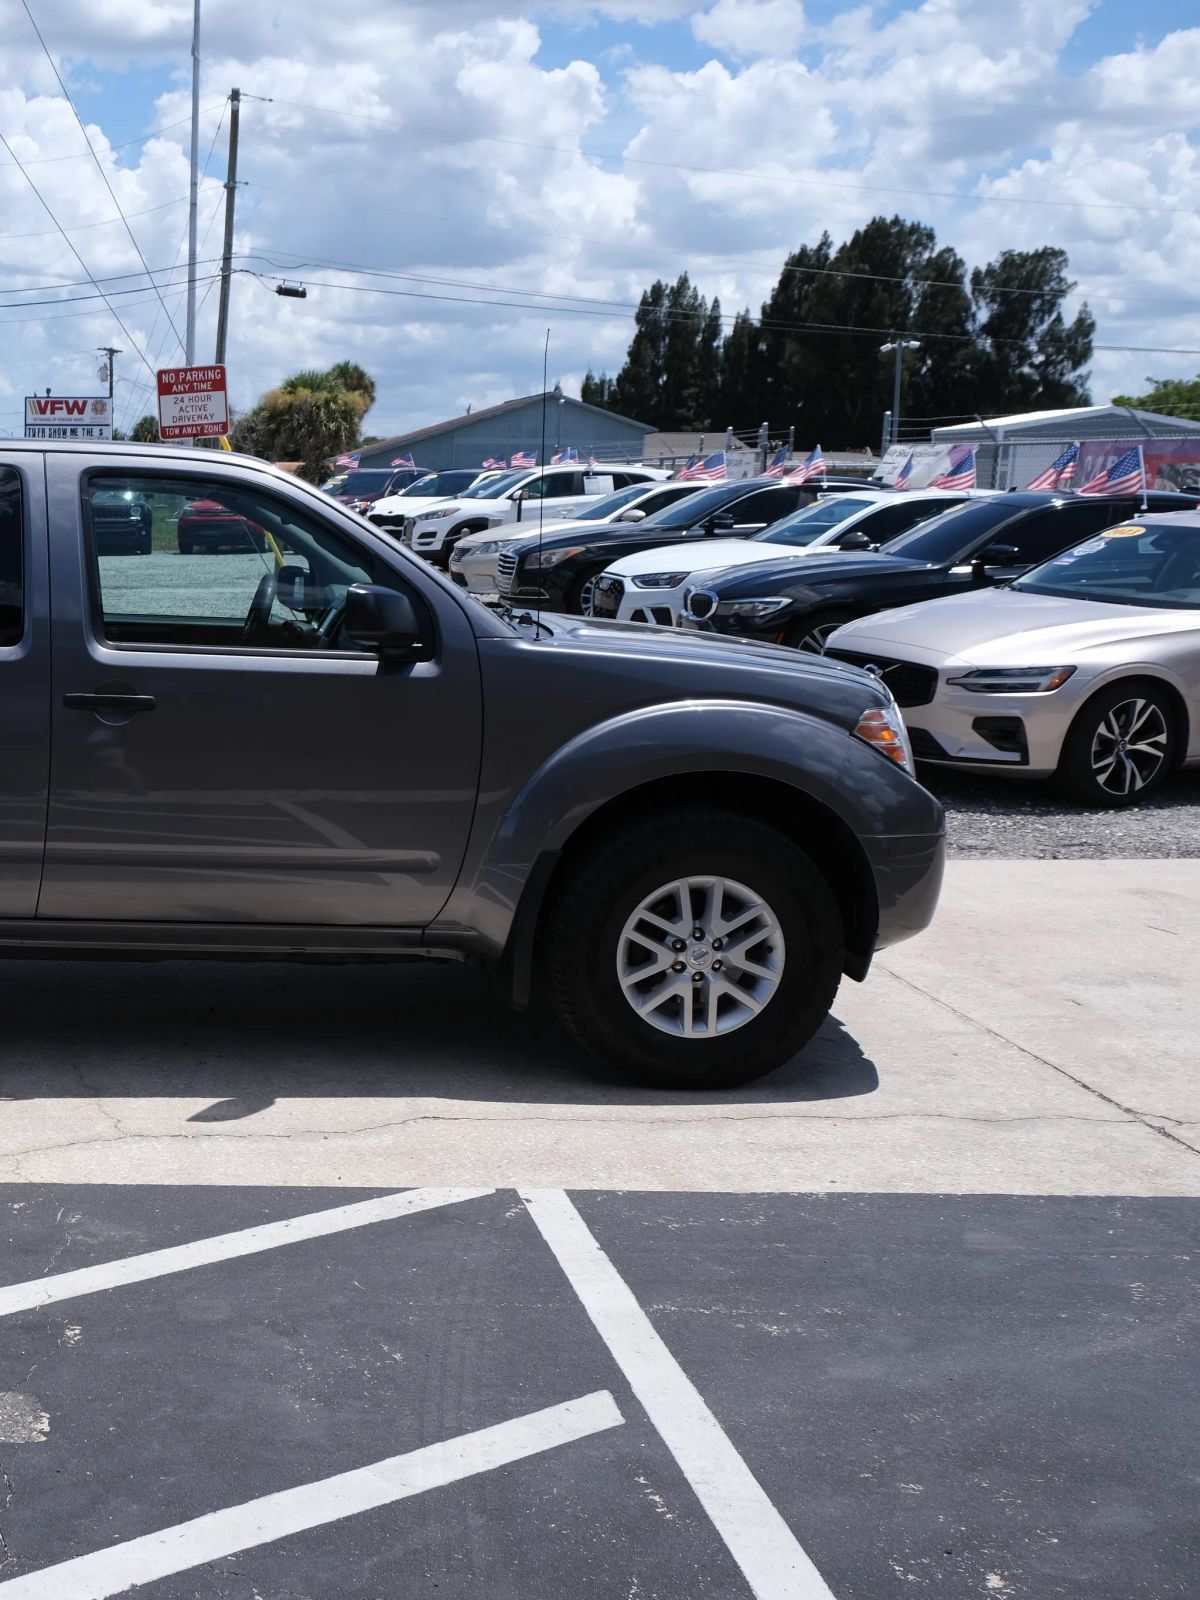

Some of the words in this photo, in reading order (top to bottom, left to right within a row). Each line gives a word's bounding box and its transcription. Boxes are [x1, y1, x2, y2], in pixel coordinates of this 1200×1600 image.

[162, 373, 176, 384] NO
[180, 369, 222, 382] PARKING
[172, 384, 190, 392] ANY
[193, 382, 213, 390] TIME
[174, 396, 184, 404] 24
[188, 394, 212, 403] HOUR
[36, 400, 88, 415] VFW
[178, 404, 208, 414] ACTIVE
[172, 413, 215, 424] DRIVEWAY
[70, 428, 78, 436] ME
[82, 428, 94, 436] THE
[165, 427, 180, 436] TOW
[182, 425, 202, 434] AWAY
[204, 424, 224, 433] ZONE
